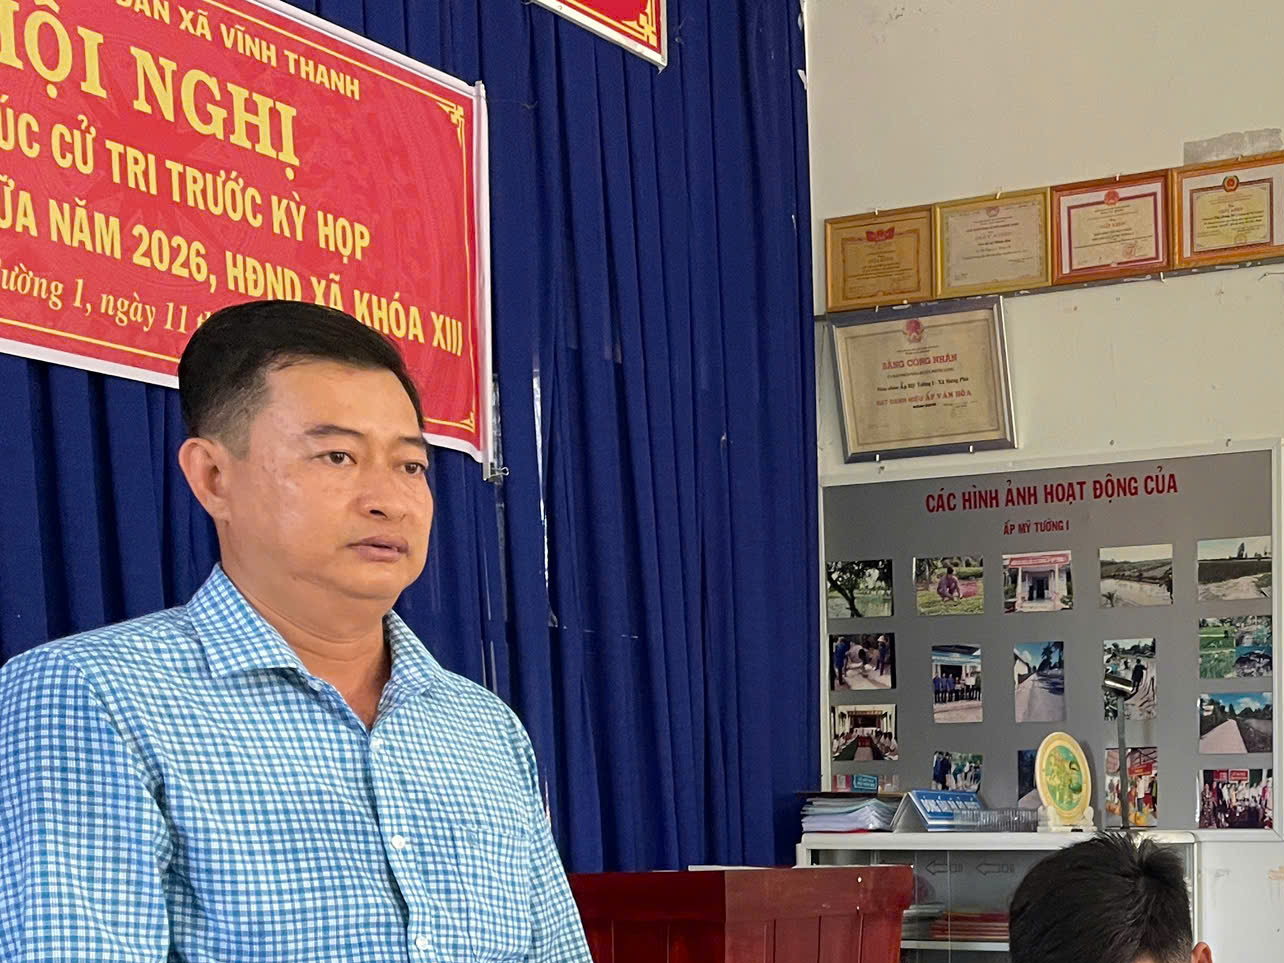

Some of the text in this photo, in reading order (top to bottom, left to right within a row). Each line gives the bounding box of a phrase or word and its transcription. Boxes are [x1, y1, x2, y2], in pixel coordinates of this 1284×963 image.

[179, 7, 212, 41] XÃ
[220, 24, 277, 67] VĨNH
[284, 50, 360, 100] THANH
[130, 45, 300, 181] NGHỊ
[52, 115, 96, 174] CỬ
[106, 140, 157, 195] TRI
[165, 160, 263, 228] TRƯỚC
[271, 192, 306, 241] KỲ
[317, 210, 370, 263] HỌP
[49, 197, 121, 259] NĂM
[132, 224, 217, 293] 2026,
[225, 251, 302, 301] HĐND
[310, 273, 343, 312] XÃ
[353, 292, 424, 344] KHÓA
[430, 311, 462, 356] XIII
[73, 279, 91, 316] 1,
[101, 292, 156, 332] ngày
[164, 302, 187, 333] 11
[925, 465, 1178, 513] CÁC HÌNH ẢNH HOẠT ĐỘNG CỦA
[1003, 519, 1016, 535] ẤP
[1018, 519, 1031, 534] MỸ
